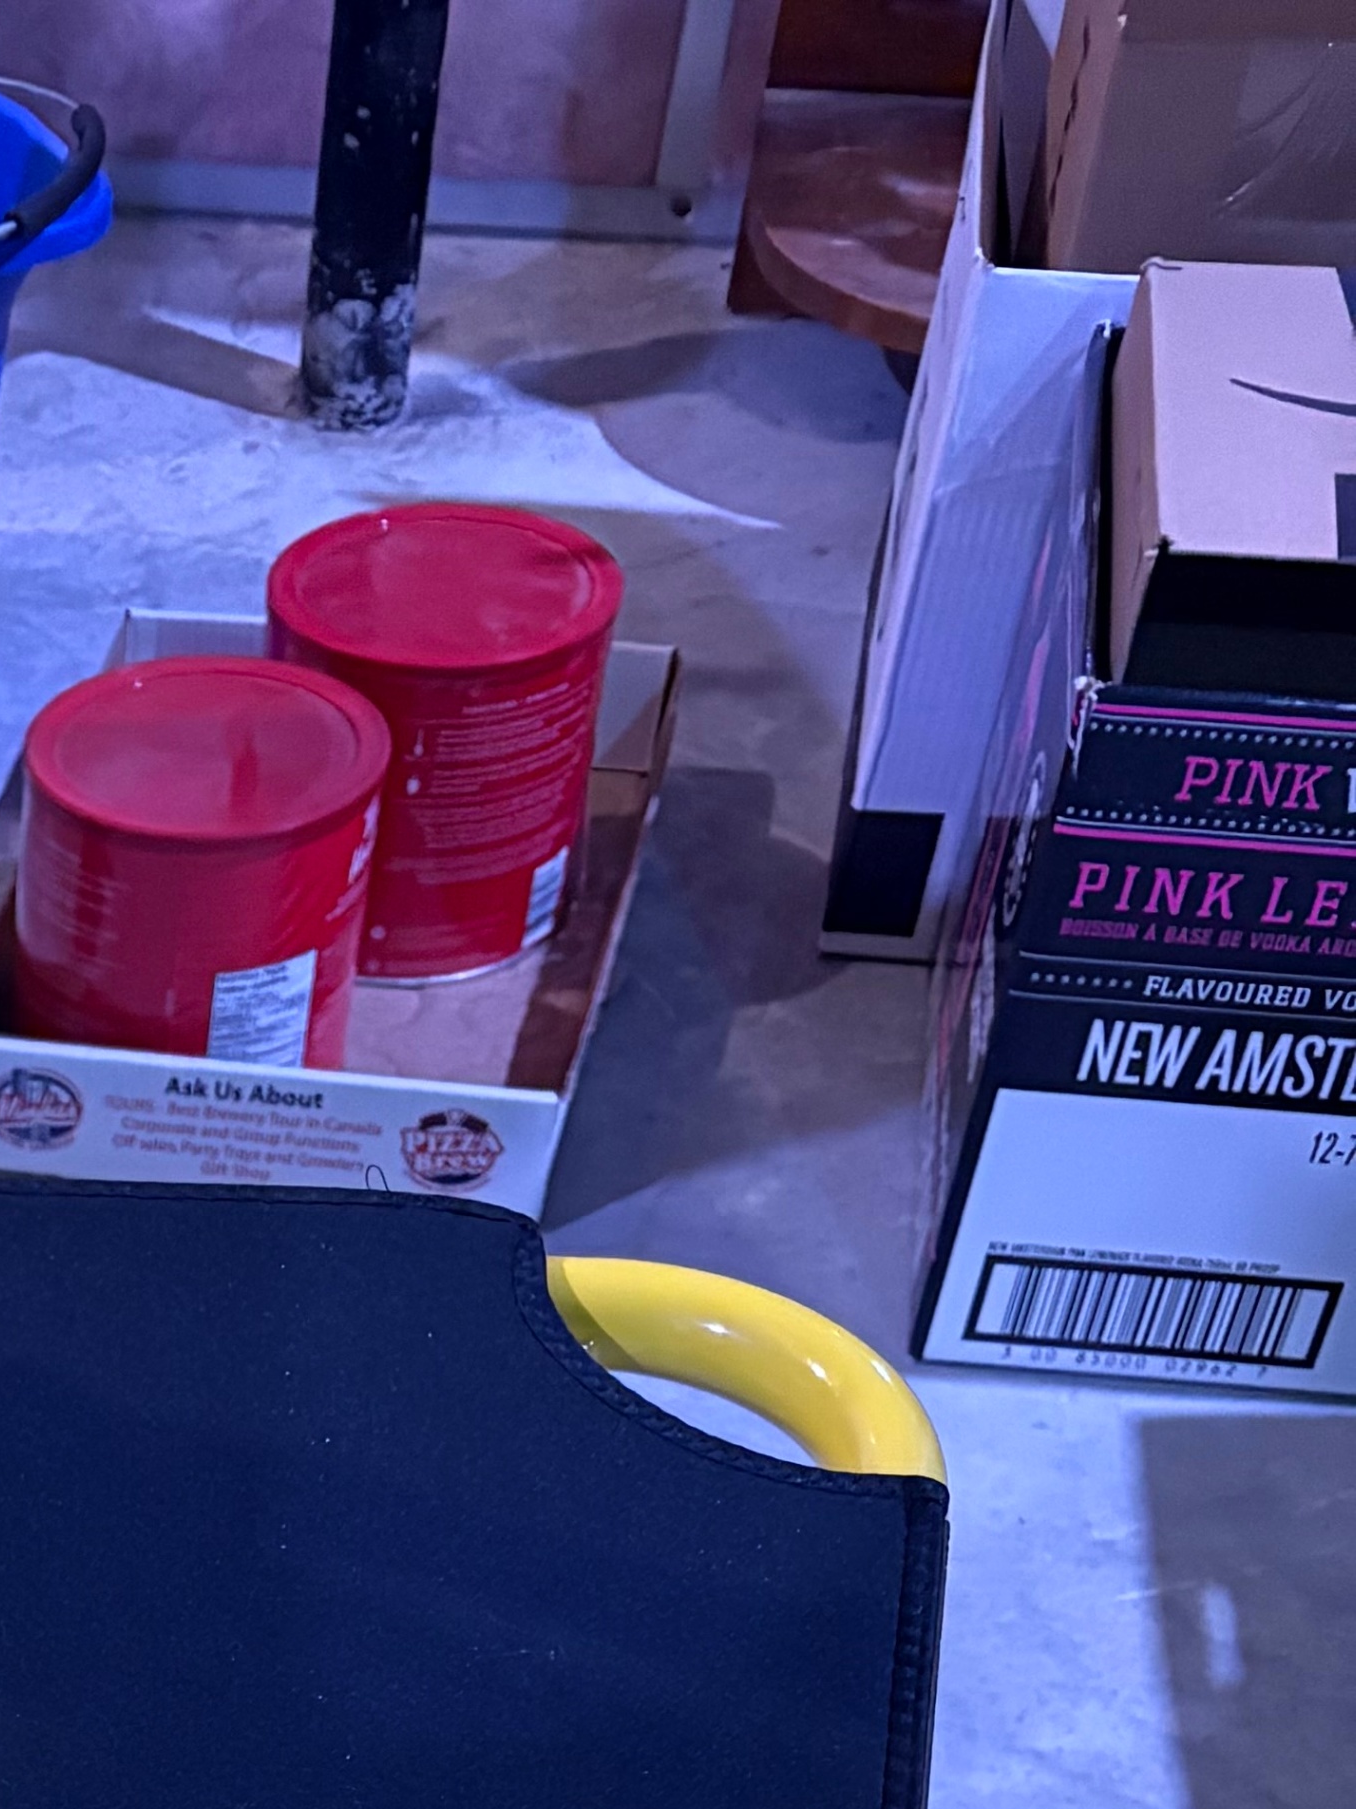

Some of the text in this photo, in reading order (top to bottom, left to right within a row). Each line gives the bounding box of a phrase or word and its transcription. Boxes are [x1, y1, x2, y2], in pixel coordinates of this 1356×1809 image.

[1174, 755, 1333, 811] PINK
[1068, 861, 1356, 928] PINK LE
[1059, 917, 1139, 940] BOISSON
[1163, 924, 1214, 947] BASE
[1217, 928, 1244, 949] DE
[1250, 931, 1311, 954] VODKA
[1143, 974, 1312, 1009] FLAVOURED
[1076, 1018, 1202, 1088] NEW
[165, 1076, 323, 1109] Ask Us About
[402, 1129, 501, 1155] PIZZA
